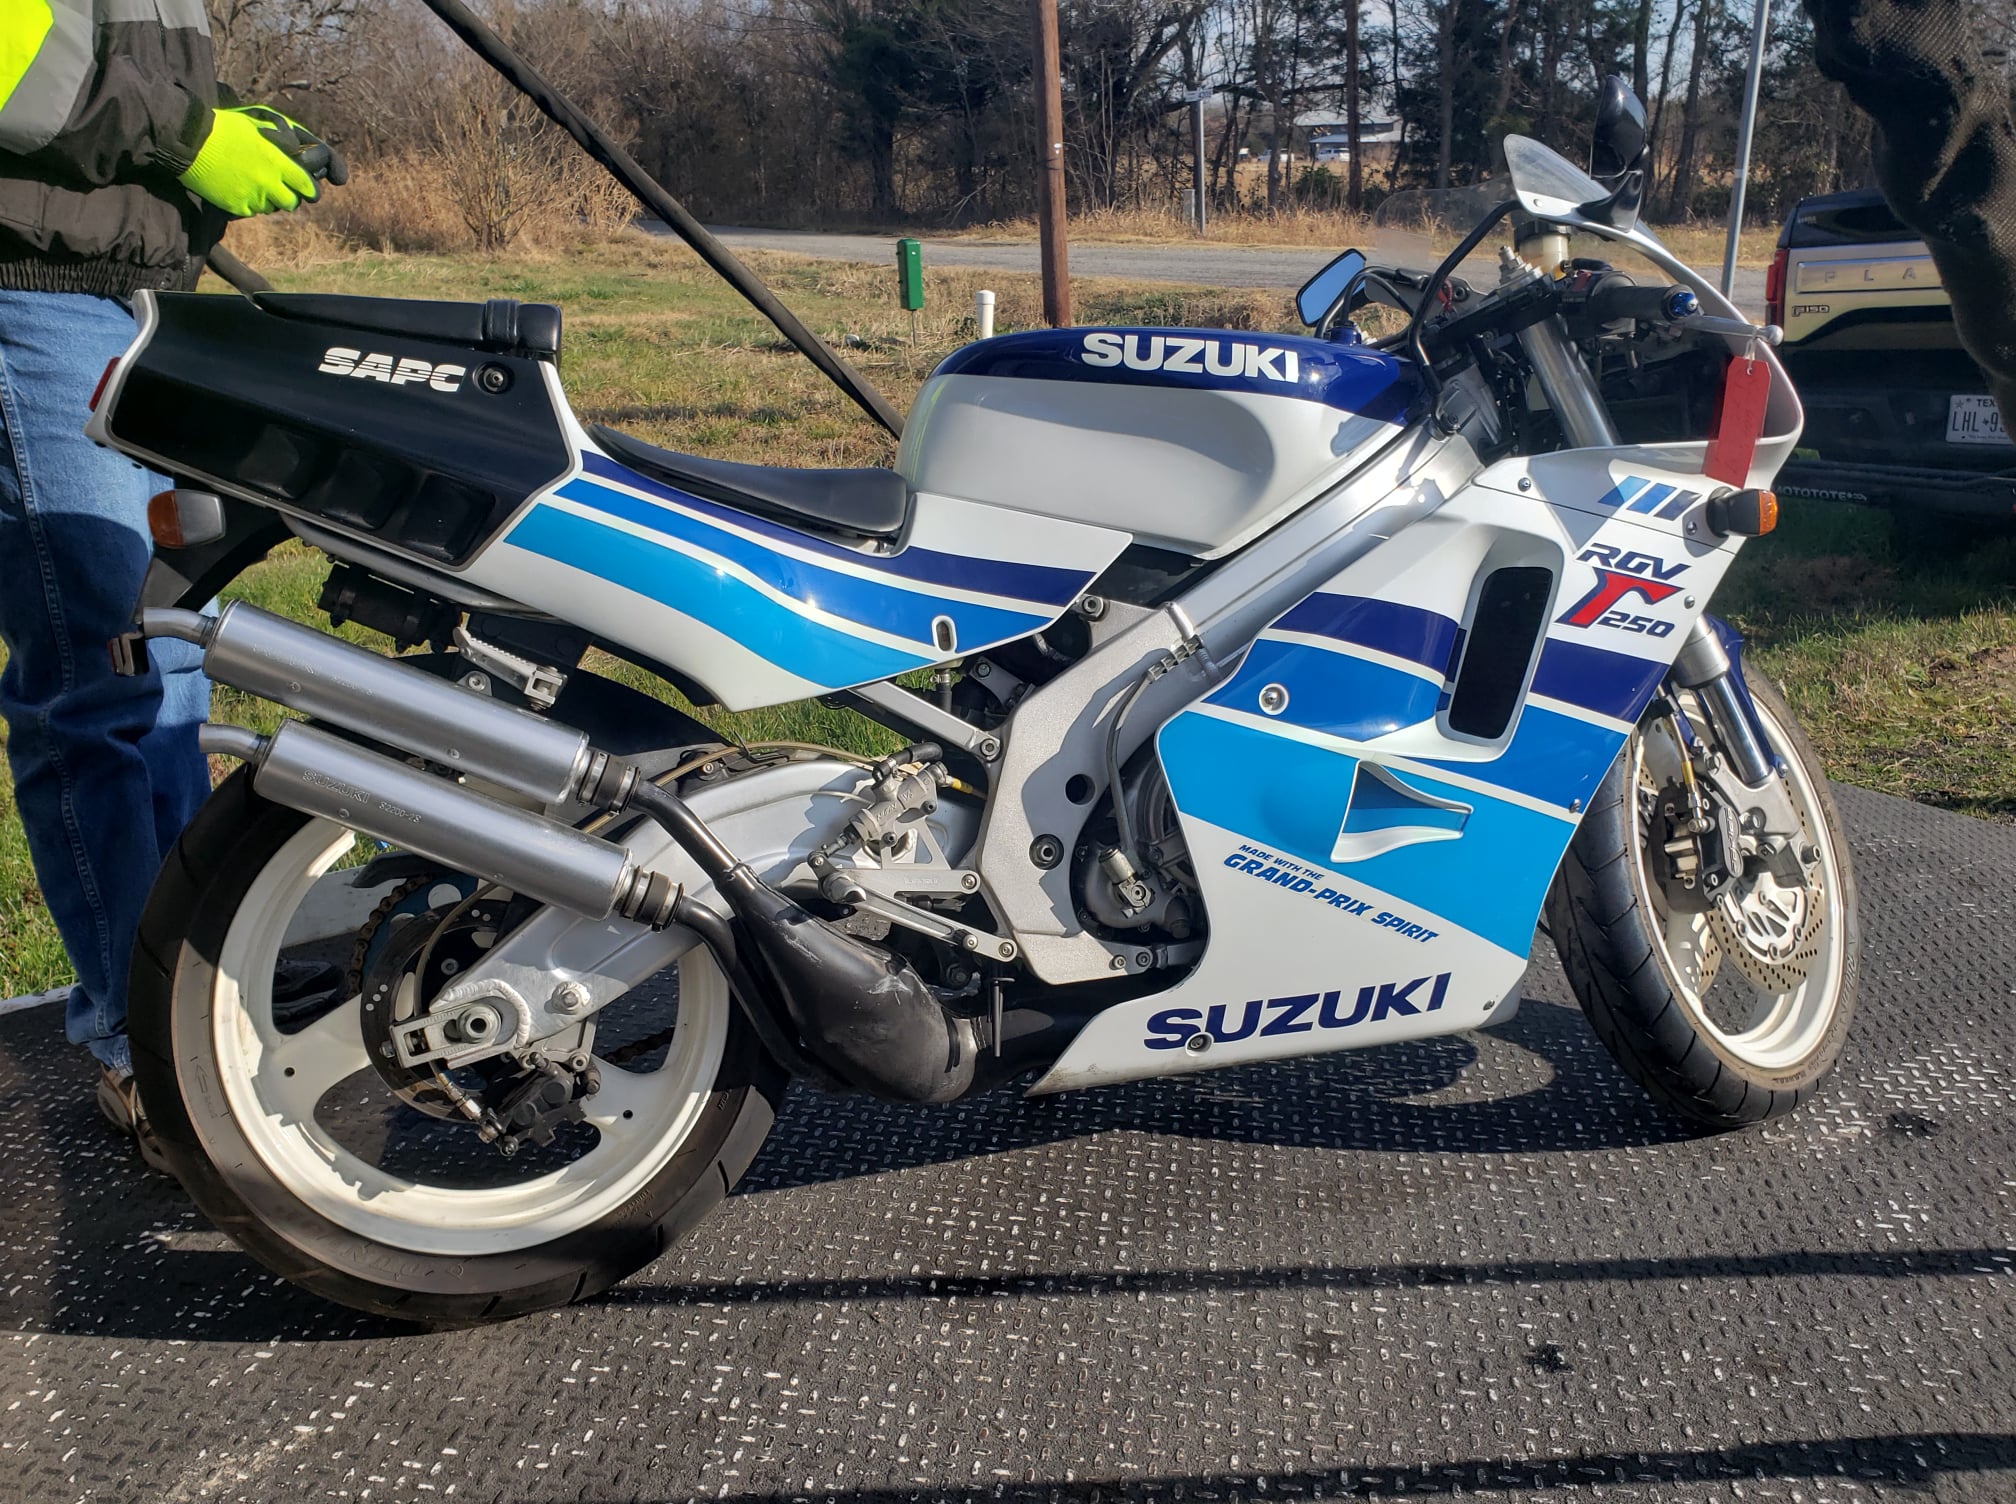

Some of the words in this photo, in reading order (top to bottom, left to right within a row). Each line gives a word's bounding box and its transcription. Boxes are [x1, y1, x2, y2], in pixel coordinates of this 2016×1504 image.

[318, 347, 467, 392] SAPC
[1081, 333, 1300, 384] SUZUKI
[1976, 398, 1996, 408] TEX
[1576, 543, 1691, 580] RGV
[1597, 611, 1675, 638] 250
[302, 769, 371, 804] SUZUKI
[1238, 844, 1273, 864] MADE
[1274, 856, 1302, 873] WITH
[1301, 866, 1324, 881] THE
[1223, 853, 1375, 917] GRAND-PRIX
[1370, 911, 1440, 944] SPIRIT
[1143, 972, 1452, 1051] SUZUKI
